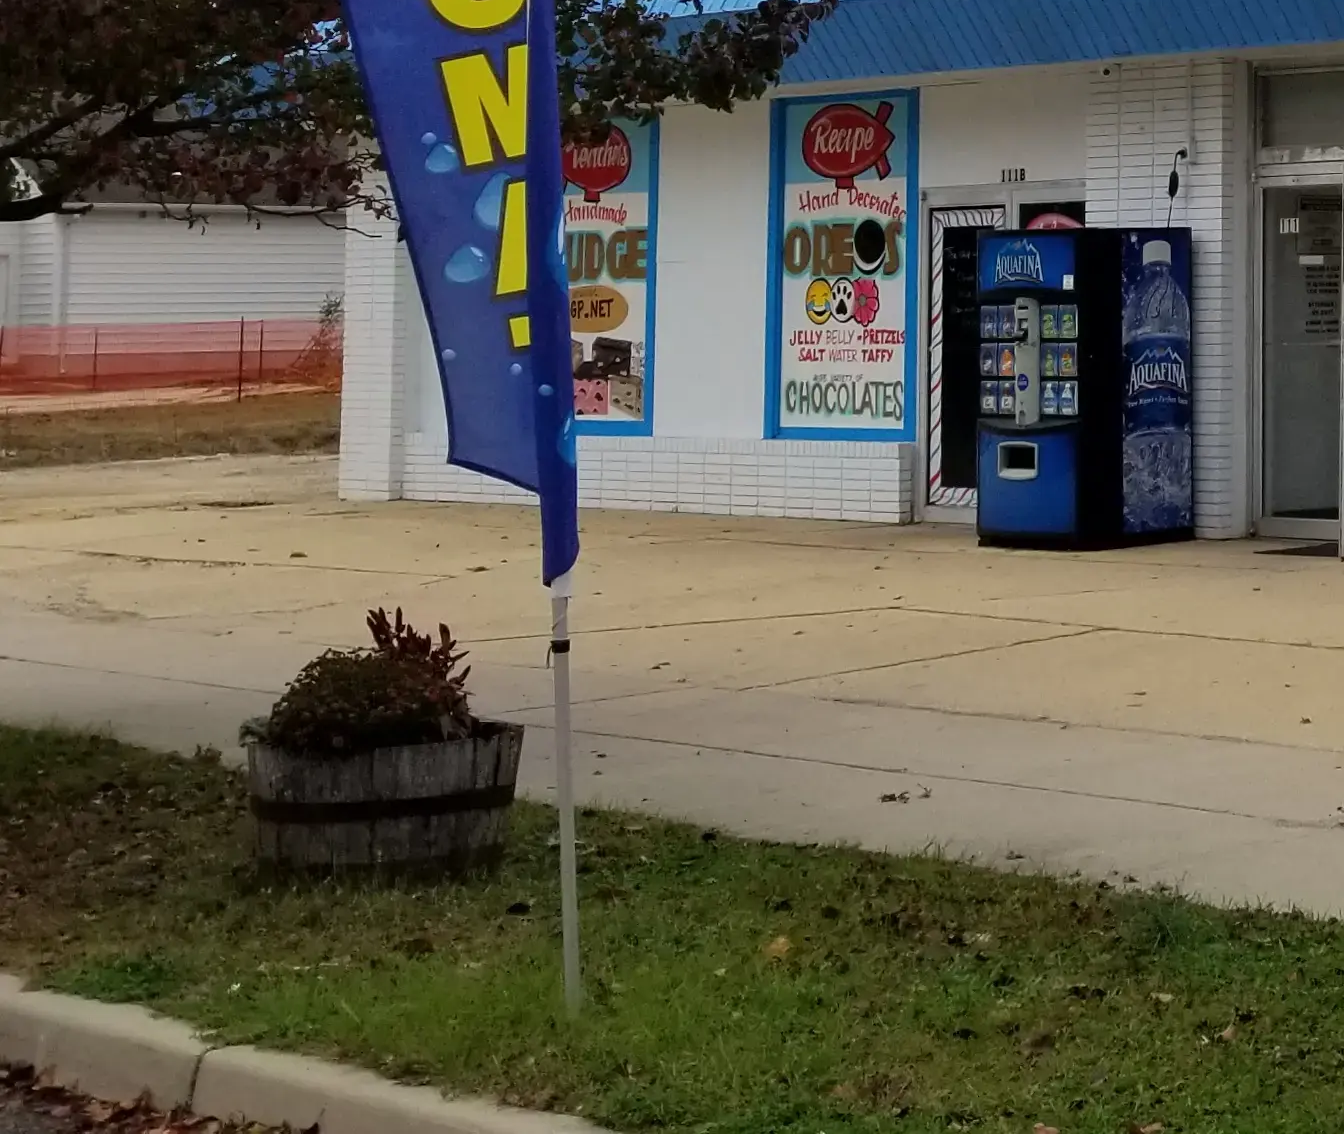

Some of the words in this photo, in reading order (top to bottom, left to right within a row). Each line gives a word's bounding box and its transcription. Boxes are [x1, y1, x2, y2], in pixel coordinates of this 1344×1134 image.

[811, 116, 875, 164] Recipe
[1001, 168, 1026, 182] 111B
[799, 189, 839, 213] Hand
[565, 229, 648, 282] UDGE
[994, 253, 1044, 283] AQUAFINA
[789, 330, 823, 346] JELLY
[826, 329, 855, 345] BELLY
[862, 328, 905, 345] PRETZELS
[798, 347, 826, 362] SALT
[828, 348, 858, 363] WATER
[861, 349, 894, 363] TAFFY
[1128, 361, 1188, 396] AQUAFINA
[785, 380, 904, 421] CHOCOLATES
